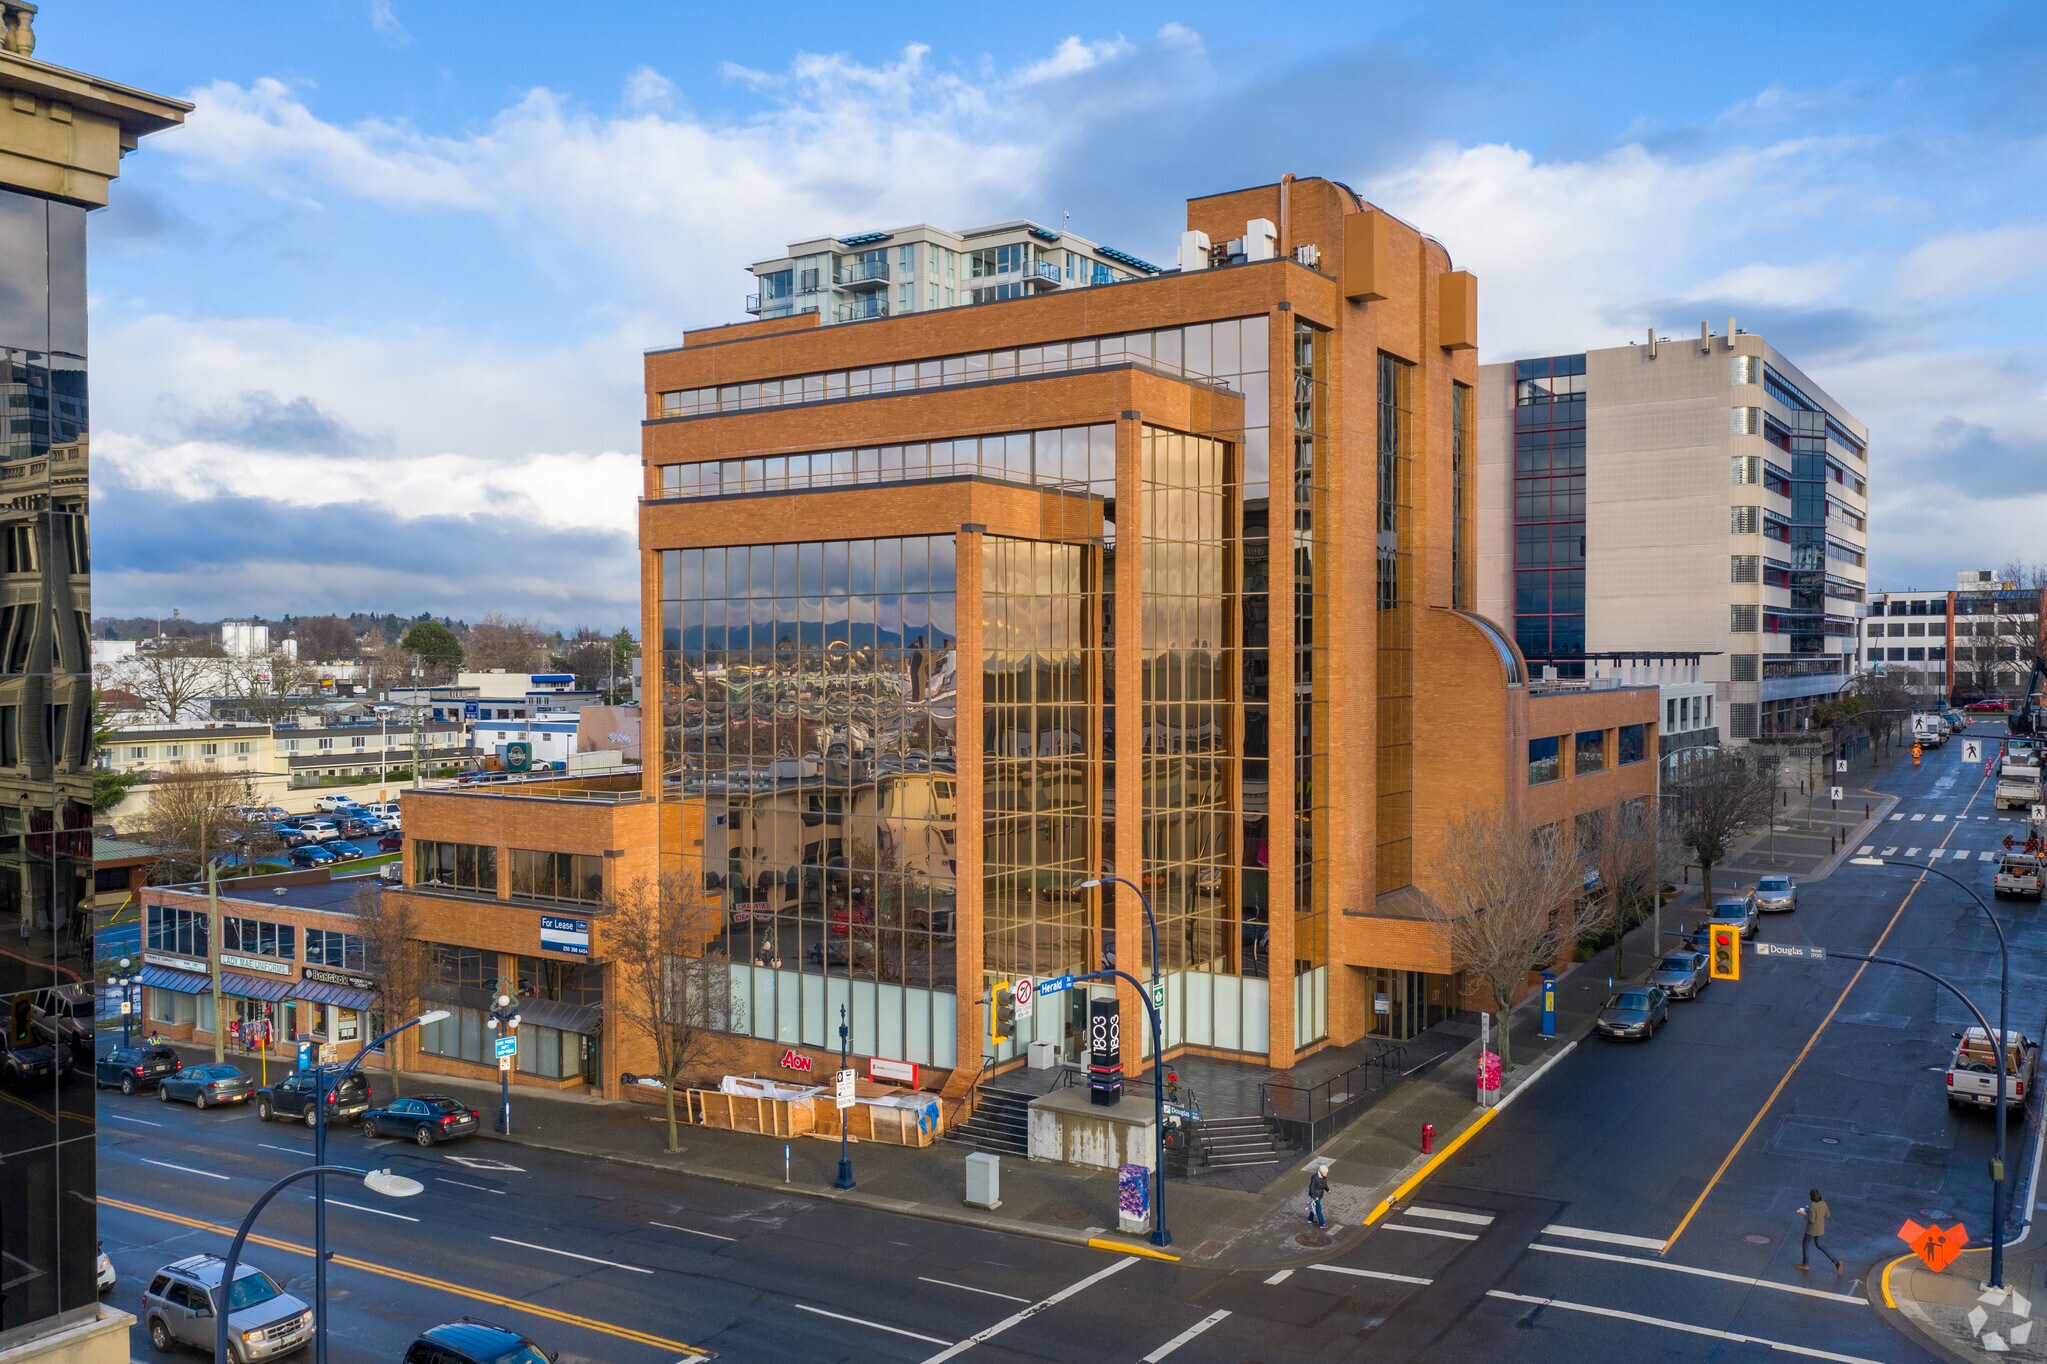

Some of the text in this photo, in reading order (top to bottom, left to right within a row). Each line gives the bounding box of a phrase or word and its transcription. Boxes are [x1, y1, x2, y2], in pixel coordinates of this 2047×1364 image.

[542, 917, 553, 928] For
[554, 919, 574, 930] Lease
[1770, 944, 1804, 956] Douglas
[222, 955, 286, 974] LADY MAE UNIFORMS
[1041, 979, 1063, 994] Herald
[1092, 1015, 1107, 1052] 1803
[1110, 1014, 1119, 1052] 1803
[781, 1050, 812, 1072] AON
[1171, 1106, 1190, 1117] Douglas
